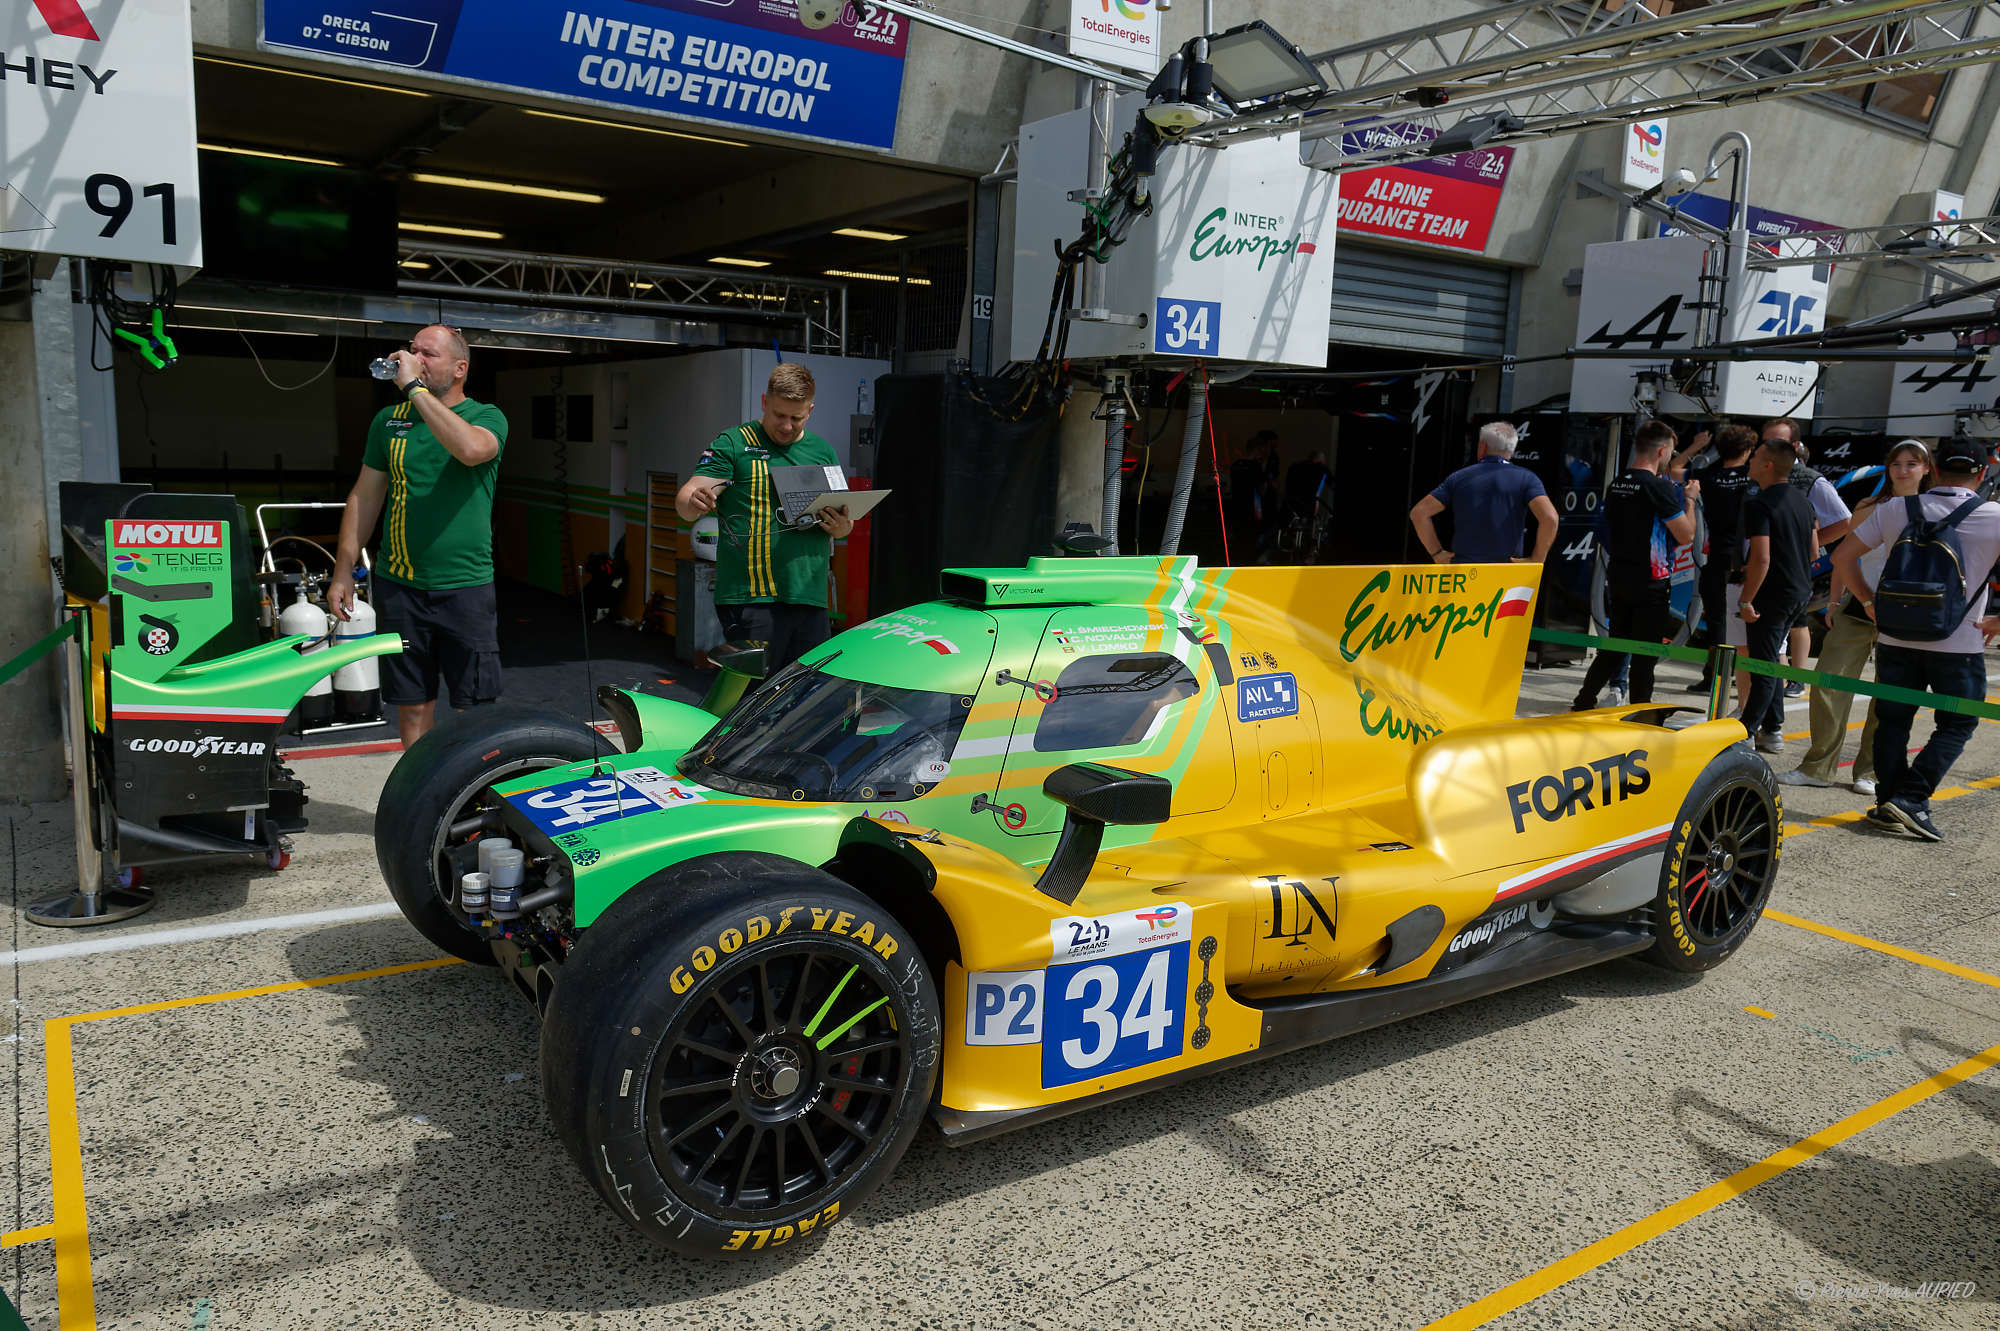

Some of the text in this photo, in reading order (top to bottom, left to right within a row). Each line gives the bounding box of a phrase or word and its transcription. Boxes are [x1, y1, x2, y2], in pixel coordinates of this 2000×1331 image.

[321, 14, 371, 33] ORECA
[854, 29, 896, 45] LE MANS
[1081, 16, 1151, 44] TotalEnergies
[303, 25, 322, 40] 07
[335, 31, 390, 52] GIBSON
[559, 12, 832, 92] INTER EUROPOL
[578, 53, 815, 122] COMPETITION
[1364, 177, 1433, 208] ALPINE
[84, 173, 177, 246] 91
[1234, 211, 1278, 231] INTER
[1190, 207, 1302, 271] Europol
[1419, 213, 1470, 239] TEAM
[974, 297, 992, 317] 19
[1165, 304, 1210, 350] 34
[1756, 372, 1804, 386] ALPINE
[118, 524, 218, 544] MOTUL
[152, 552, 223, 566] TENEG
[1402, 573, 1467, 595] INTER
[1339, 570, 1504, 662] Europol
[147, 645, 171, 655] PZM
[1085, 633, 1145, 642] NOVALAK
[1246, 686, 1273, 705] AVL
[1248, 705, 1285, 718] RACETECH
[130, 736, 266, 758] GOODYEAR
[527, 779, 652, 827] 34
[1506, 749, 1652, 834] FORTIS
[1068, 919, 1110, 946] 24h
[1138, 931, 1179, 944] TotalEnergies
[1449, 904, 1528, 953] GOODYEAR
[669, 906, 900, 995] GOODYEAR
[1067, 941, 1109, 955] LE MANS
[975, 982, 1036, 1036] P2
[1060, 950, 1175, 1070] 34
[721, 1200, 840, 1251] EAGLE
